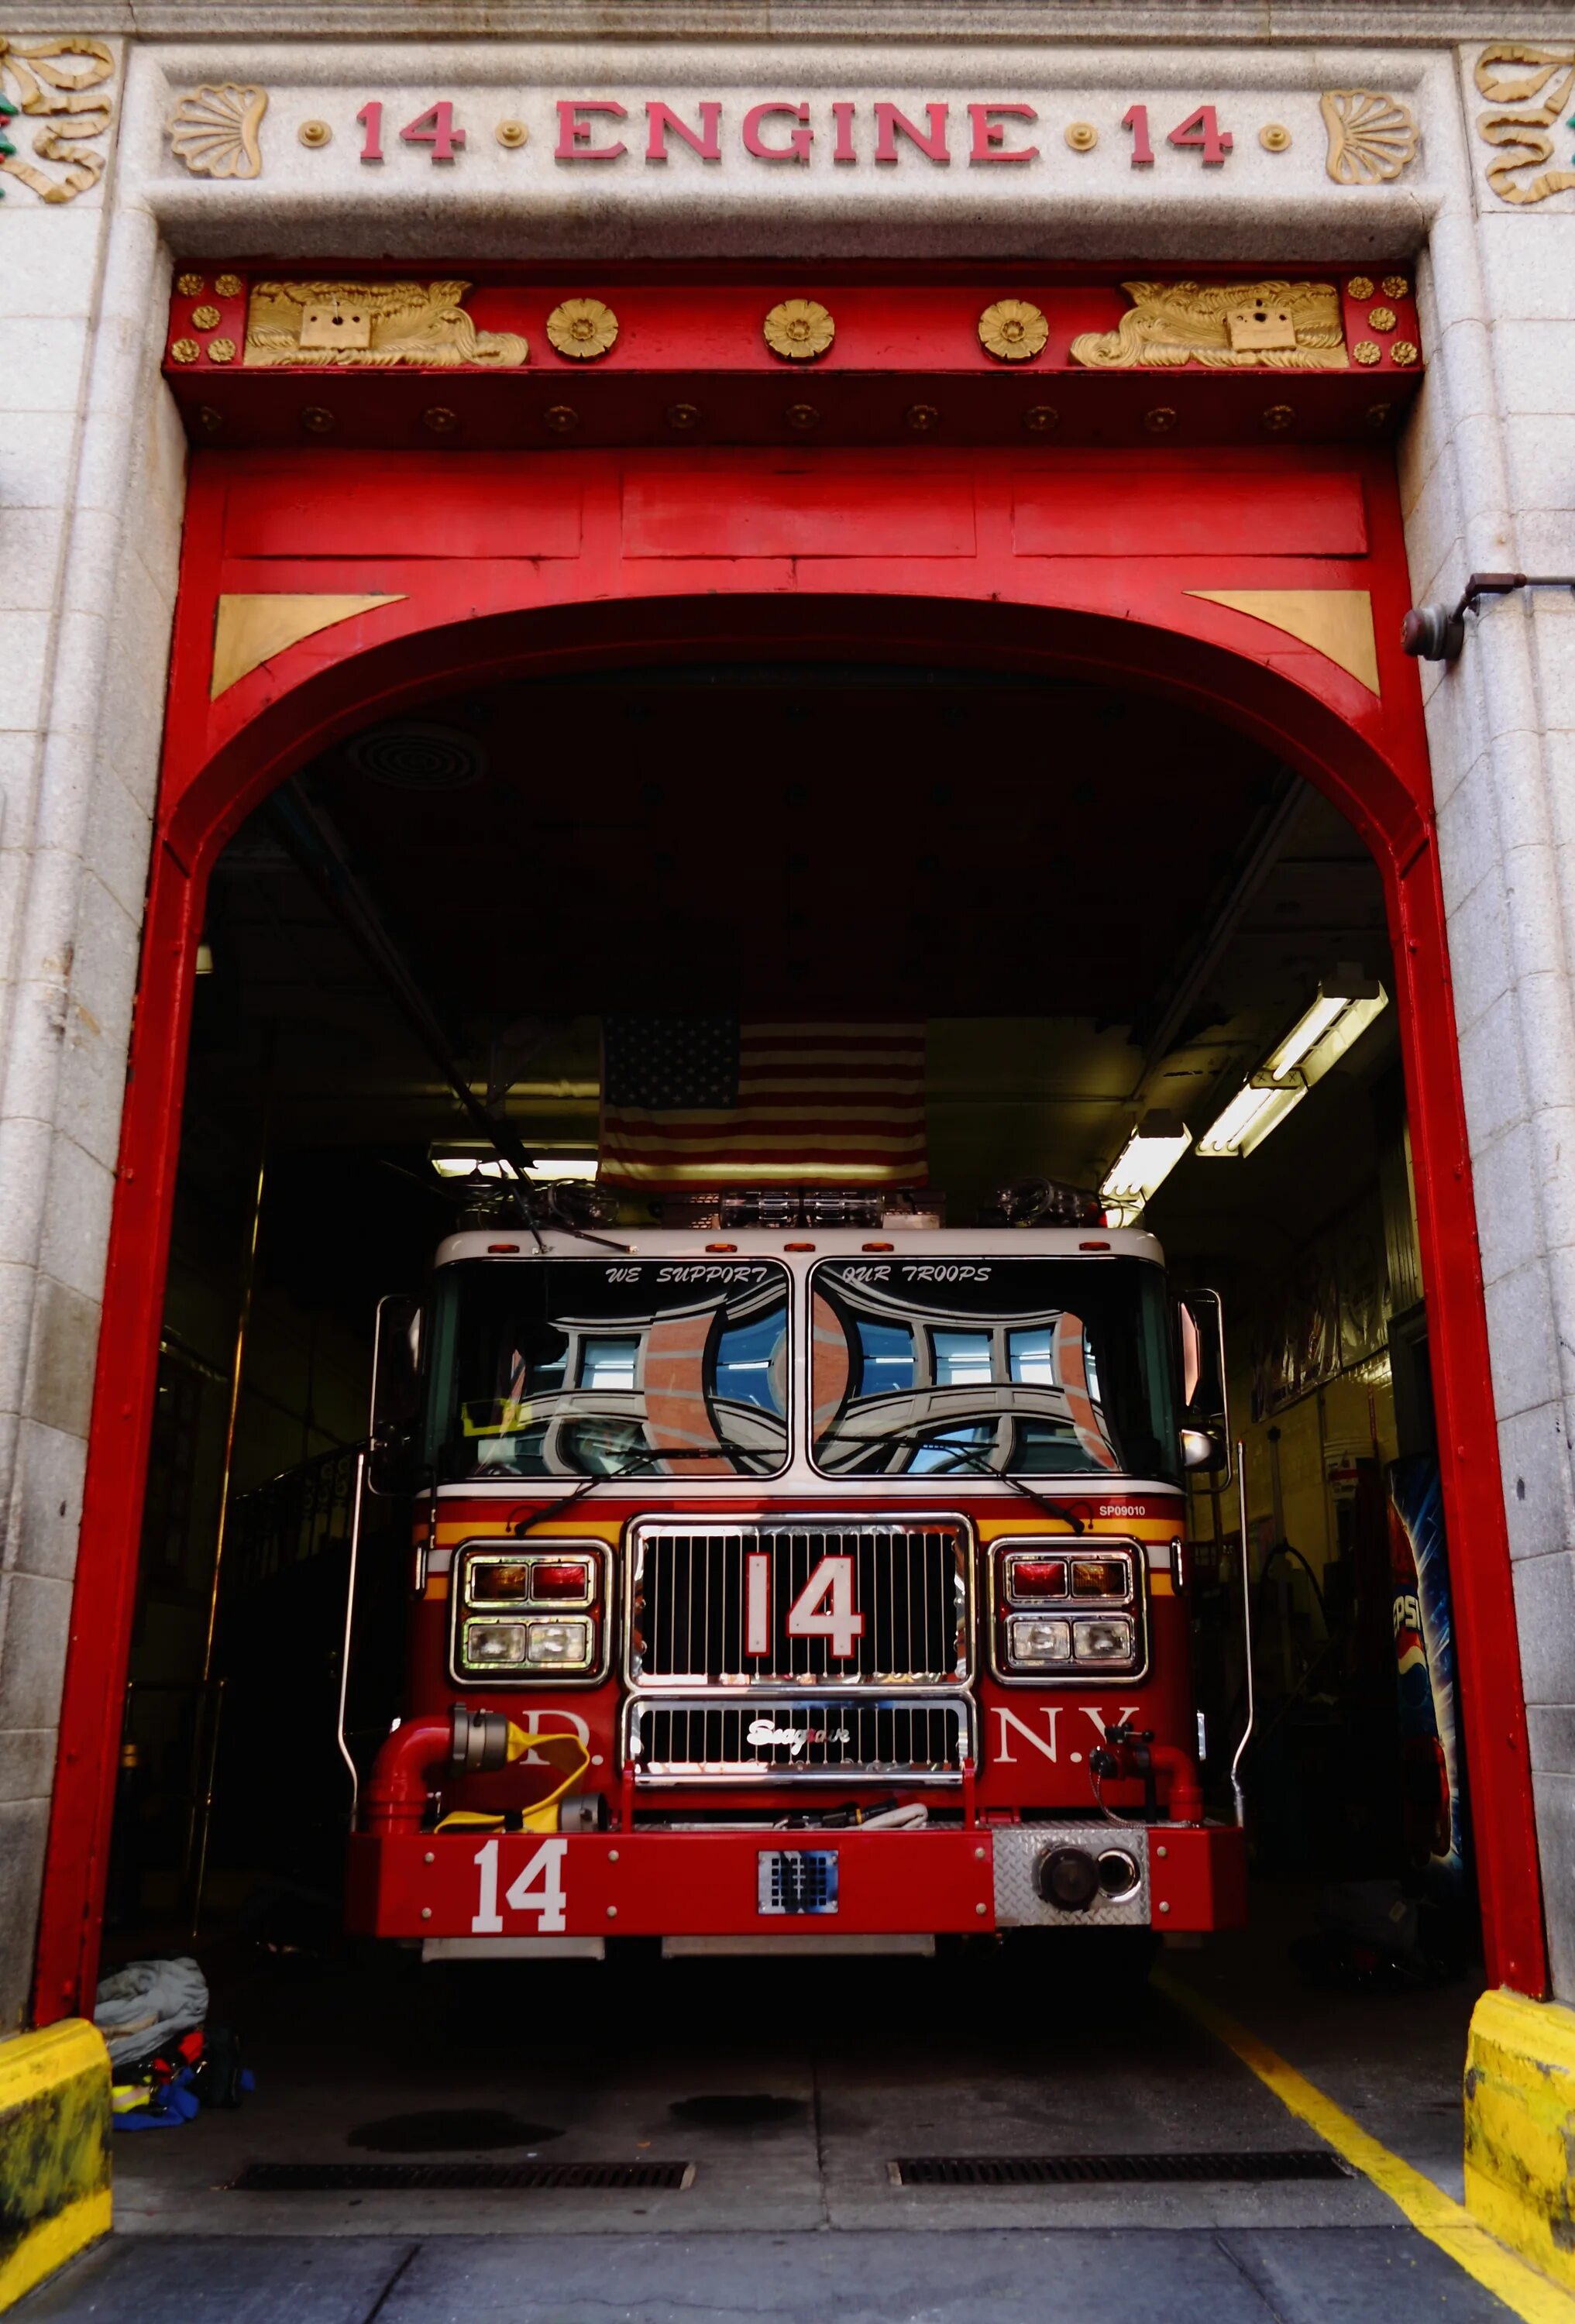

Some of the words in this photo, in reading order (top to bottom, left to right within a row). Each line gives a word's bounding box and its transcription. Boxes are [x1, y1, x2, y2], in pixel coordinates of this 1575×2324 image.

[356, 100, 467, 162] 14
[554, 100, 1041, 163] ENGINE
[1121, 105, 1235, 166] 14
[605, 1267, 642, 1284] WE
[656, 1267, 769, 1284] SUPPORT
[842, 1265, 891, 1284] OUR
[901, 1265, 992, 1282] TROOPS
[1099, 1505, 1146, 1516] SP09010
[745, 1552, 865, 1659] 14
[471, 1838, 569, 1934] 14
